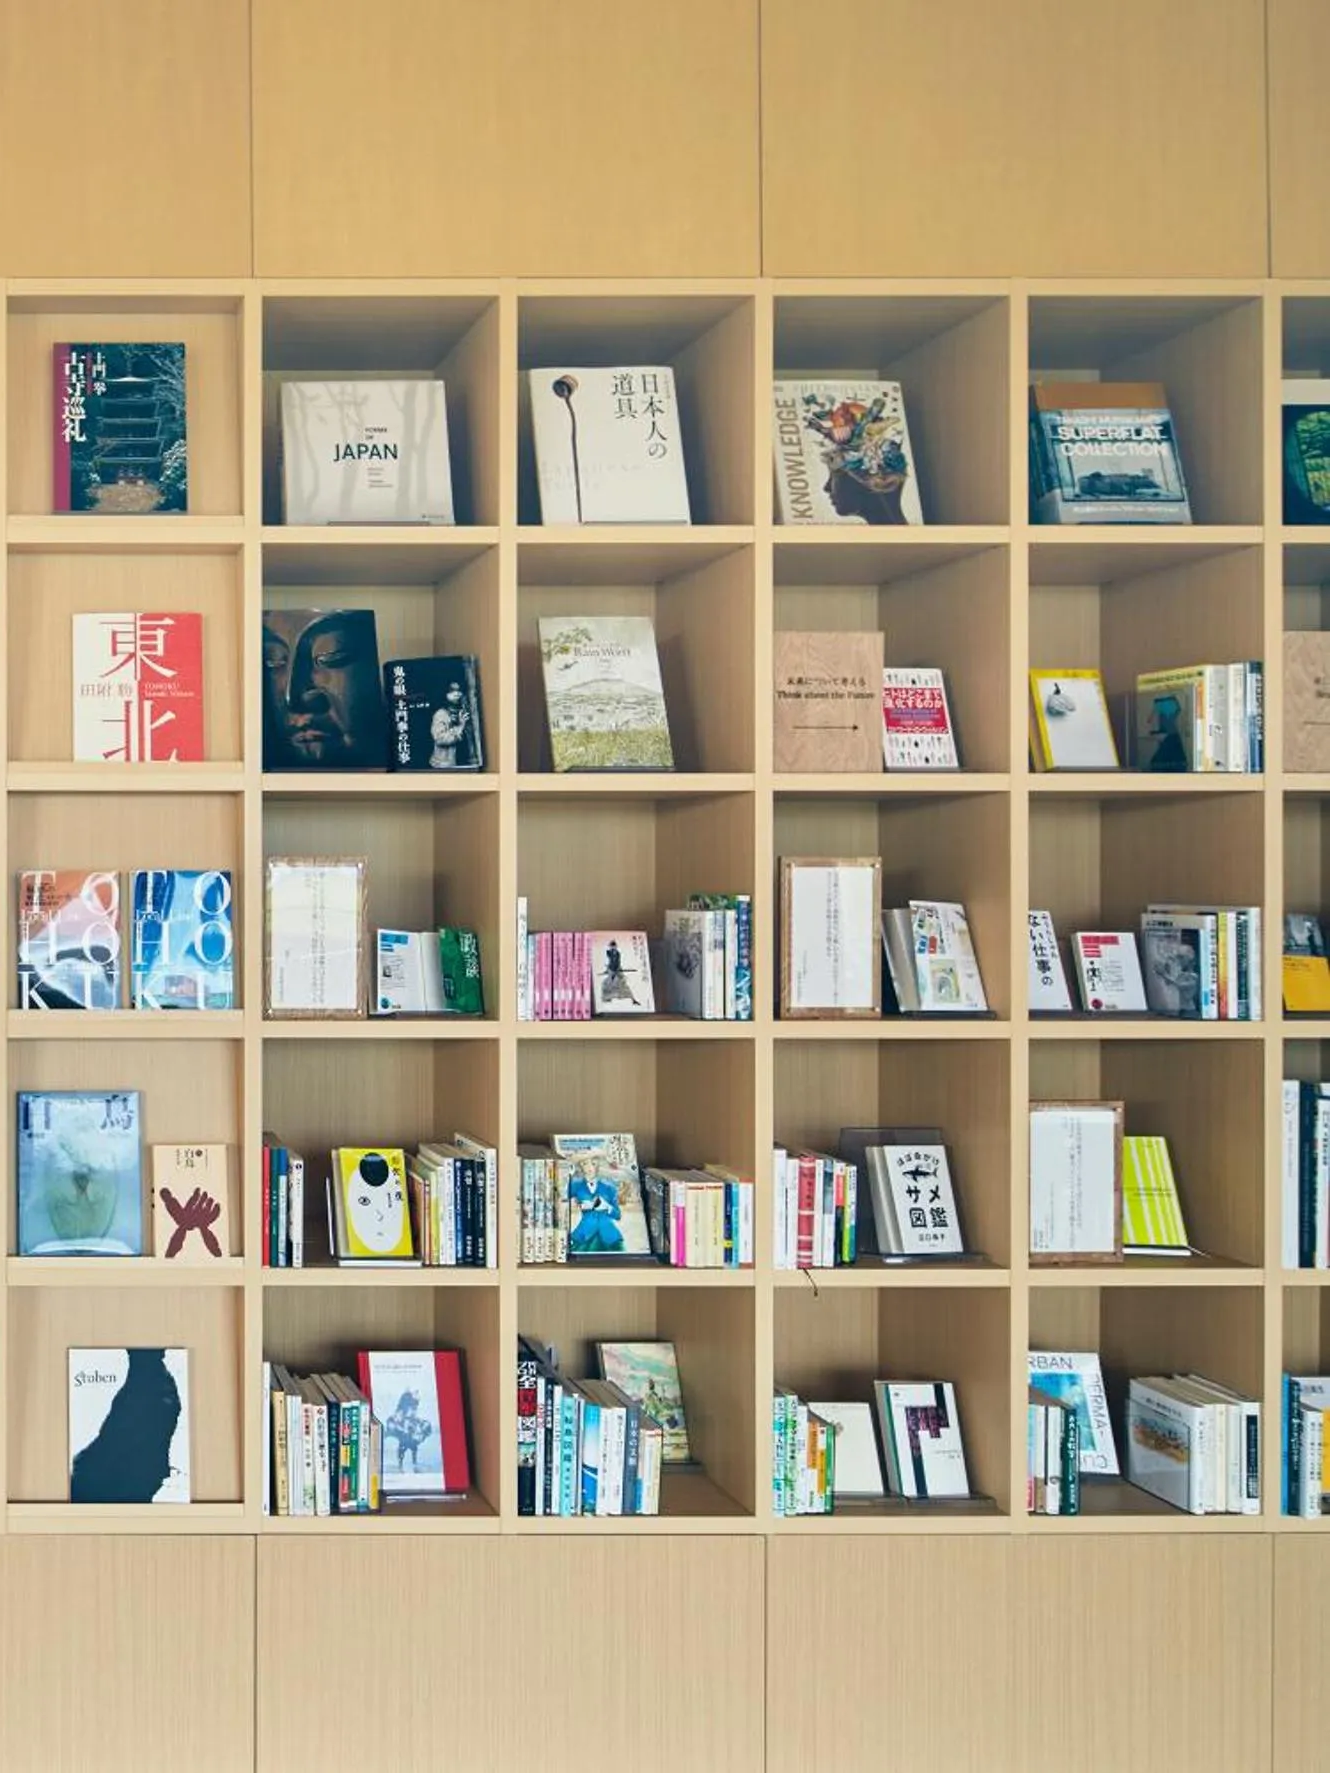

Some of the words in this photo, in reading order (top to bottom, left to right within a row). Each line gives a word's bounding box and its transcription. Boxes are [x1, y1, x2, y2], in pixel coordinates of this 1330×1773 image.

[61, 351, 87, 443] 古寺巡礼
[611, 374, 637, 419] 道具
[640, 373, 668, 460] 日本人の
[333, 443, 398, 462] JAPAN
[1057, 425, 1163, 440] SUPERFLAT
[775, 398, 813, 519] KNOWLEDGE
[99, 613, 178, 762] 東北
[906, 1185, 940, 1203] サメ
[909, 1207, 949, 1228] 図鑑
